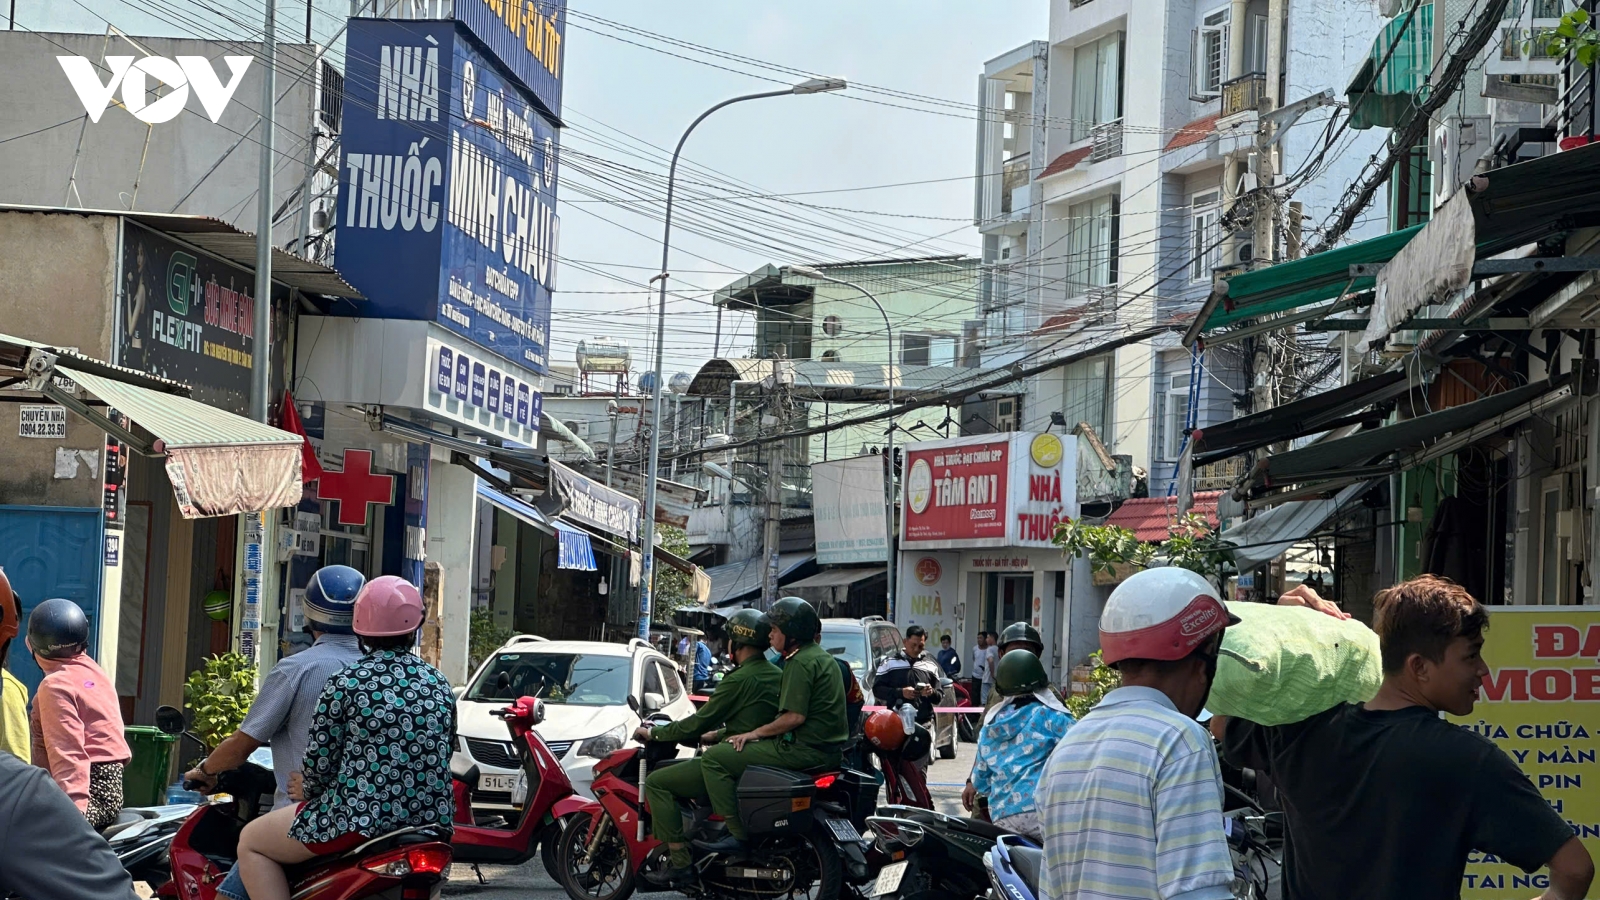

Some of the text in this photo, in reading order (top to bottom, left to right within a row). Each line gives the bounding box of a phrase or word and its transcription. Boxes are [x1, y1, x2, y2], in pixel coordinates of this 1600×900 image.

[377, 34, 439, 122] NHÀ
[487, 88, 534, 166] NHÀ THUỐC
[346, 136, 442, 233] THUỐC
[447, 129, 500, 253] MINH
[502, 172, 551, 286] CHÂU
[204, 273, 219, 328] SỨC
[219, 276, 238, 334] KHỎE
[238, 286, 255, 346] CỘN
[152, 309, 202, 354] FLEXFIT
[51, 409, 65, 421] NHÀ
[20, 423, 65, 436] 0904.22.33.50
[945, 449, 962, 466] THUỐC
[963, 452, 974, 467] ĐẠT
[973, 444, 991, 464] CHUẨN
[991, 449, 1002, 462] GPP
[934, 468, 966, 507] TÂM
[1029, 469, 1061, 503] NHÀ
[970, 508, 996, 521] Pharmacy
[911, 590, 943, 616] NHÀ
[733, 624, 756, 637] CSTT
[1182, 605, 1217, 633] Excelite
[1516, 720, 1590, 739] CHỮA
[1538, 745, 1596, 764] MÀN
[485, 777, 515, 789] 51L-5
[1539, 775, 1581, 788] PIN
[1463, 875, 1550, 889] TAI NG
